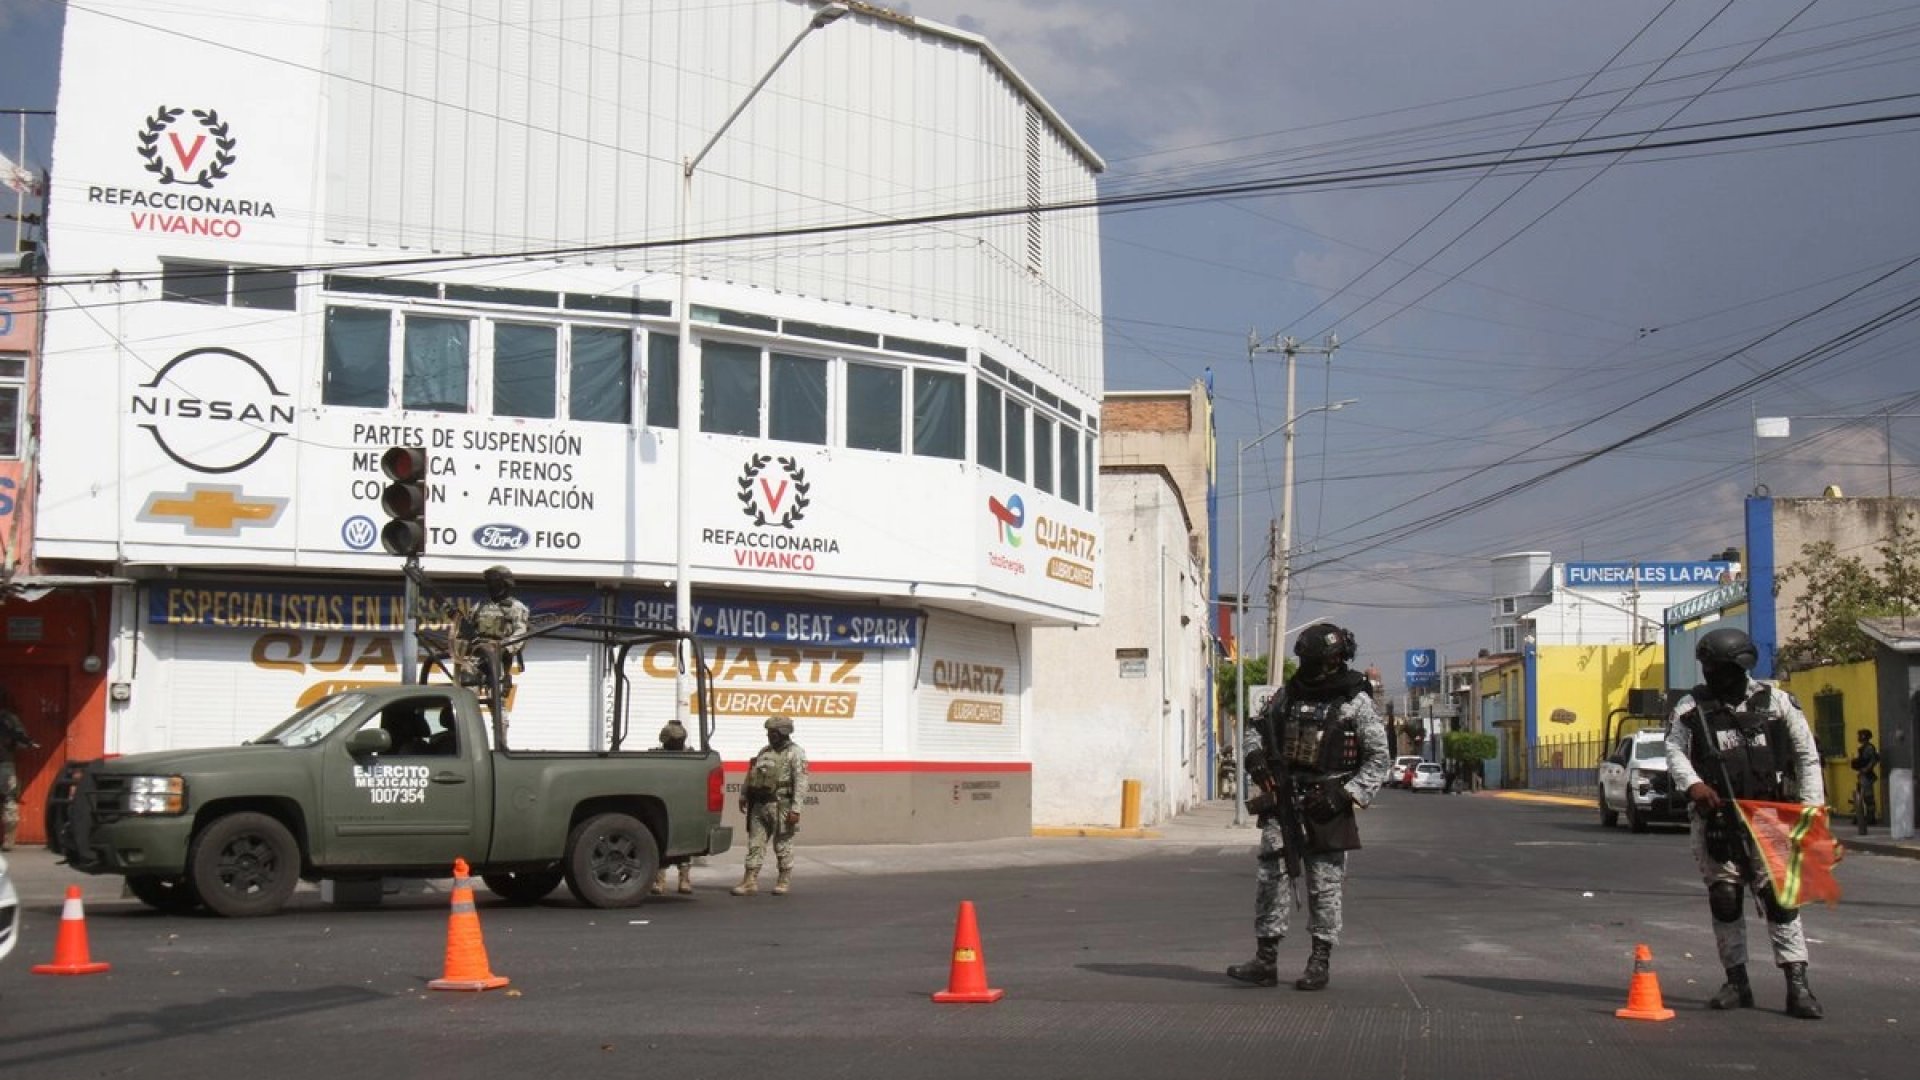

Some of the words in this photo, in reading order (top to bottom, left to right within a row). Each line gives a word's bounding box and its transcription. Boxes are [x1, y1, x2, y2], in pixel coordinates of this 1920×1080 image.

[88, 186, 276, 218] REFACCIONARIA
[131, 212, 242, 238] VIVANCO
[132, 395, 294, 424] NISSAN
[353, 424, 424, 447] PARTES
[432, 428, 455, 449] DE
[463, 430, 581, 456] SUSPENSIÓN
[499, 460, 572, 482] FRENOS
[488, 485, 594, 510] AFINACIÓN
[481, 527, 525, 548] Ford
[535, 531, 581, 549] FIGO
[702, 528, 840, 553] REFACCIONARIA
[1035, 516, 1097, 562] QUARTZ
[734, 549, 815, 571] VIVANCO
[1570, 567, 1665, 582] FUNERALES
[1670, 567, 1689, 582] LA
[1694, 567, 1725, 582] PAZ
[168, 588, 344, 630] ESPECIALISTAS
[352, 596, 380, 631] EN
[634, 600, 703, 633] CHEY
[716, 607, 767, 638] AVEO
[786, 613, 833, 643] BEAT
[850, 617, 910, 645] SPARK
[933, 659, 1005, 694] QUARTZ
[353, 765, 430, 778] EJERCITO
[355, 777, 429, 788] MEXICANO
[370, 788, 425, 803] 1007354
